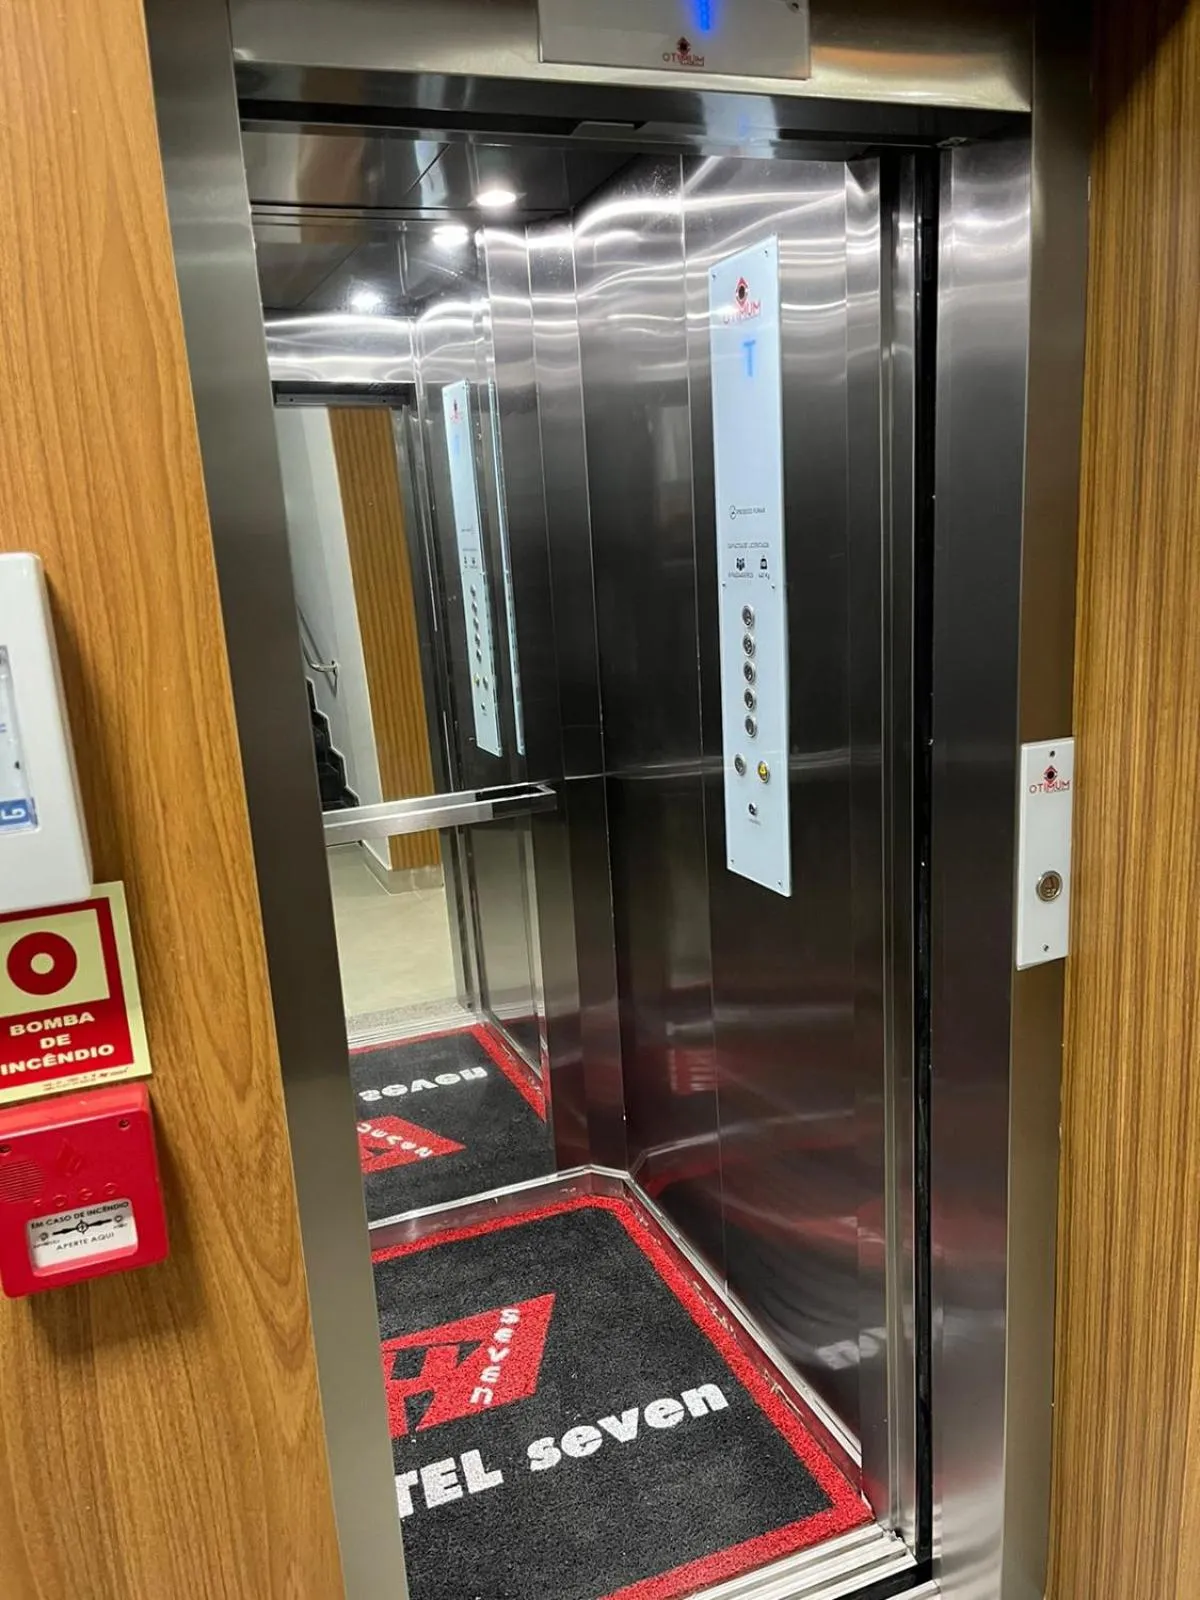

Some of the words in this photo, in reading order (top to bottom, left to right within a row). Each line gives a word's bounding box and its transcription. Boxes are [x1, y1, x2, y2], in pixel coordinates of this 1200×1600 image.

[743, 340, 756, 377] T
[1029, 780, 1070, 794] OTIMUM
[9, 1012, 96, 1037] BOMBA
[40, 1034, 72, 1049] DE
[0, 1044, 115, 1076] INCÊNDIO
[31, 1221, 44, 1229] EM
[46, 1215, 72, 1226] CASO
[86, 1201, 129, 1216] INCÊNDIO
[56, 1239, 88, 1251] APERTE
[91, 1232, 114, 1243] AQUI
[470, 1307, 521, 1405] seven
[526, 1381, 730, 1472] seven
